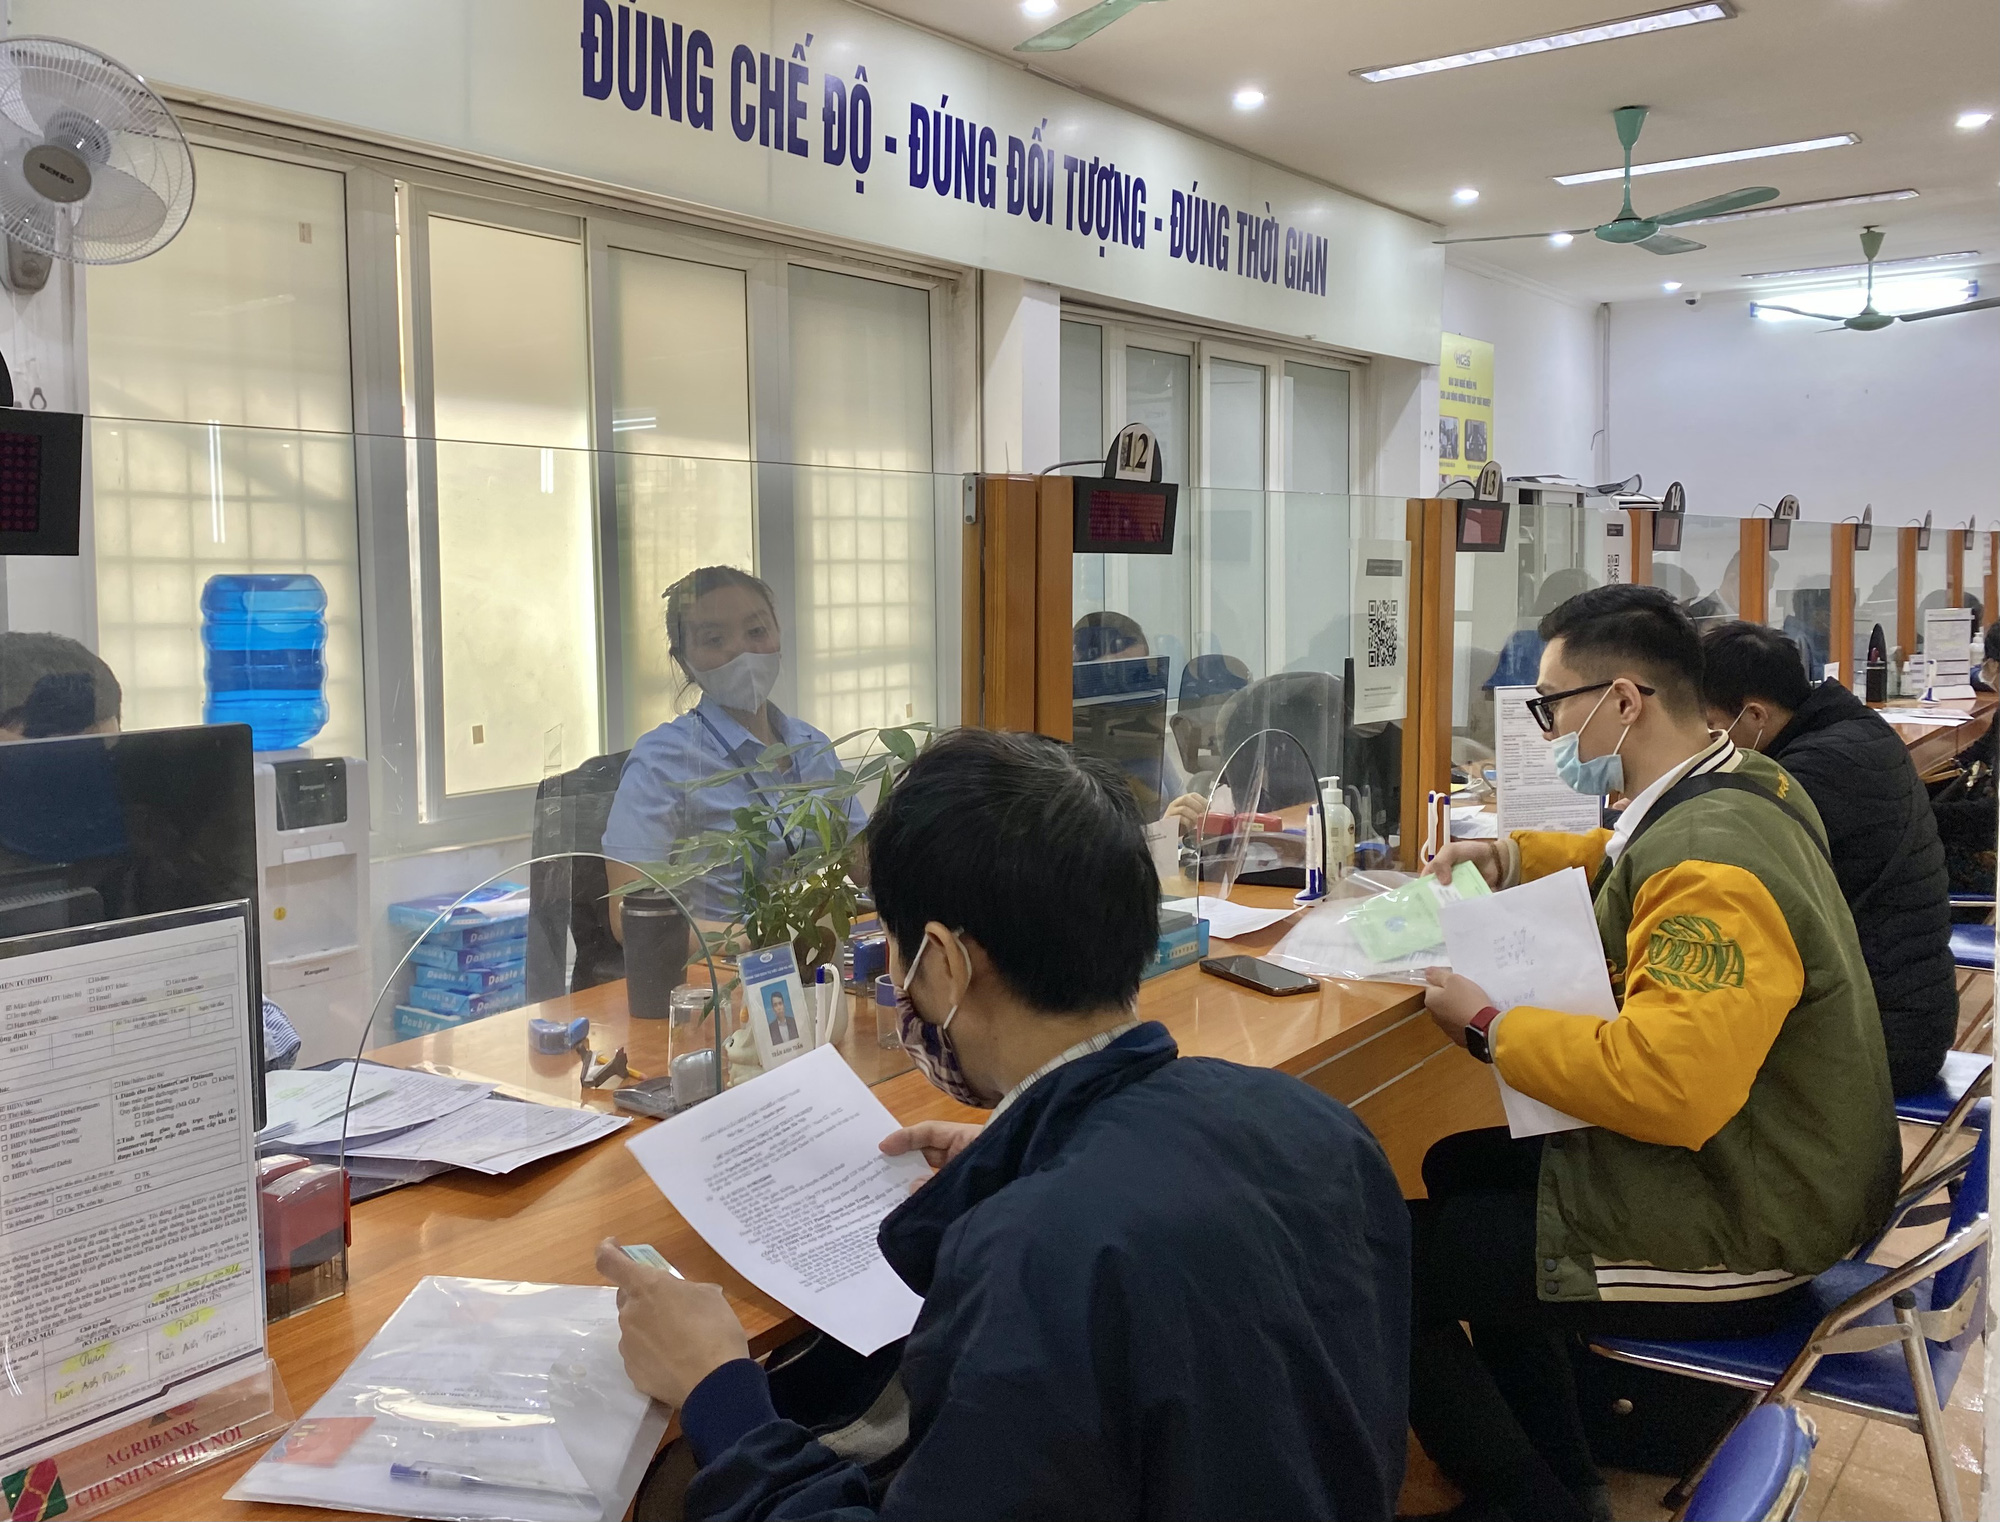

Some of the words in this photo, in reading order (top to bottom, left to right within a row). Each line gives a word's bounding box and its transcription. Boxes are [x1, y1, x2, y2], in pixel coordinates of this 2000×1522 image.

[581, 0, 714, 132] ĐÚNG
[730, 32, 814, 158] CHẾ
[822, 64, 872, 195] ĐỘ
[908, 94, 997, 210] ĐÚNG
[1006, 118, 1055, 226] ĐỐI
[1063, 154, 1147, 258] TƯỢNG
[1170, 180, 1231, 272] ĐÚNG
[1236, 201, 1280, 285] THỜI
[1284, 226, 1329, 297] GIAN
[1124, 431, 1149, 470] 12
[1482, 469, 1498, 496] 13
[1670, 485, 1682, 511] 14
[1781, 500, 1796, 516] 15
[465, 950, 503, 965] Double
[427, 970, 456, 981] Double
[488, 970, 518, 986] Double
[401, 1014, 432, 1031] Double
[105, 1418, 200, 1469] AGRIBANK
[75, 1481, 112, 1507] CHI
[113, 1452, 179, 1489] NHÁNH
[210, 1425, 244, 1449] NỘI
